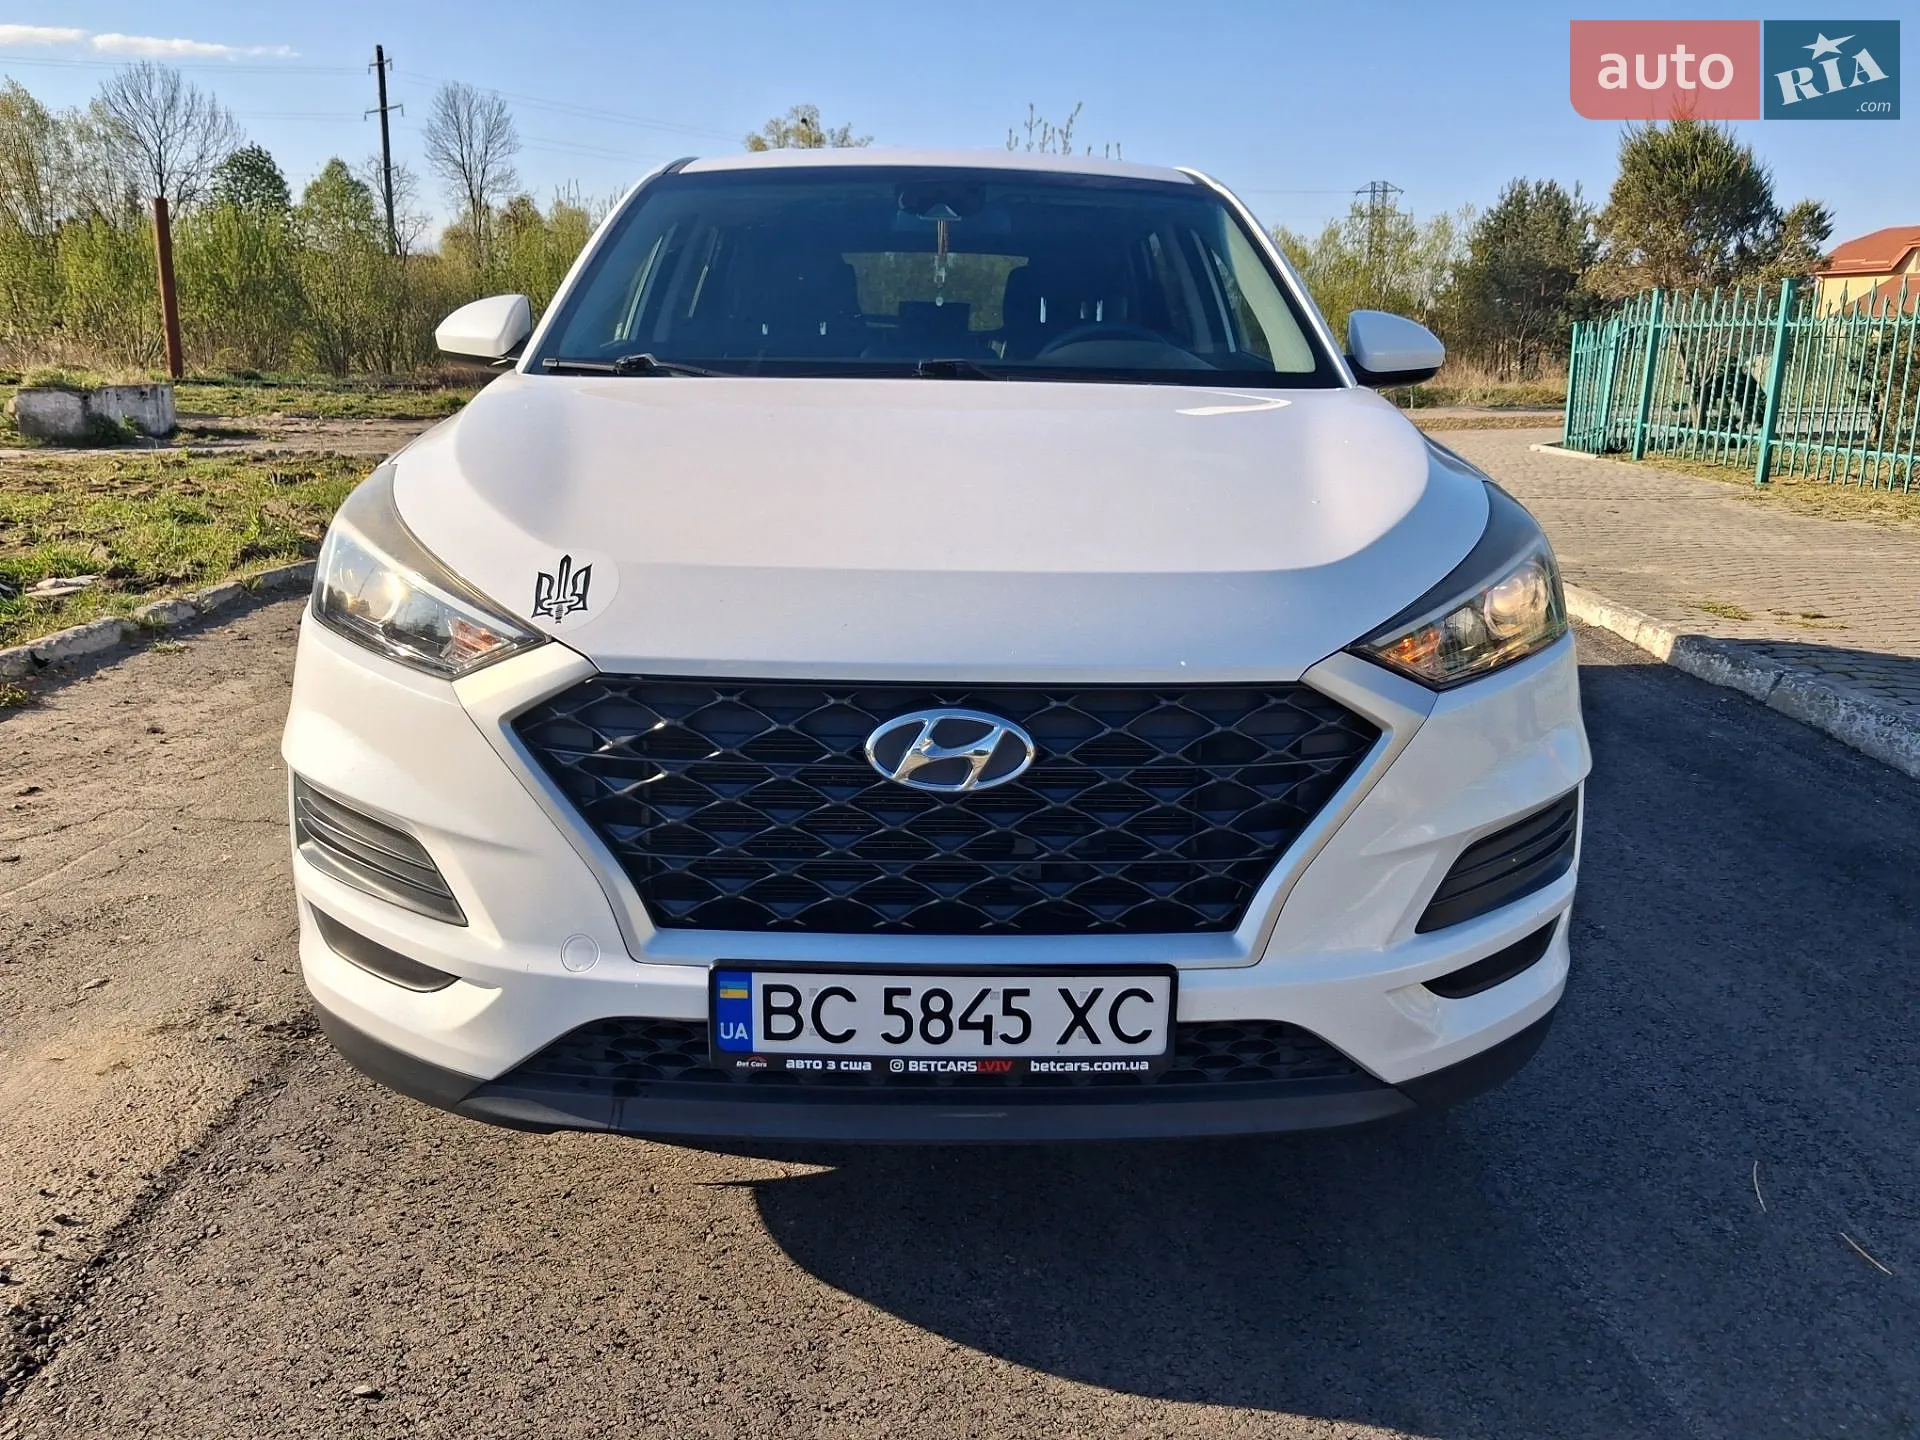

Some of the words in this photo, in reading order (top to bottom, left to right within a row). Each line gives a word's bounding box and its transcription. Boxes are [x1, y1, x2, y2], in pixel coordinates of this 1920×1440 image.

[762, 984, 857, 1044] BC
[880, 987, 1032, 1046] 5845
[1056, 987, 1155, 1045] XC
[720, 1022, 748, 1041] UA
[908, 1060, 1013, 1072] BETCARSLVIV
[1030, 1060, 1149, 1072] betcars.com.ua
